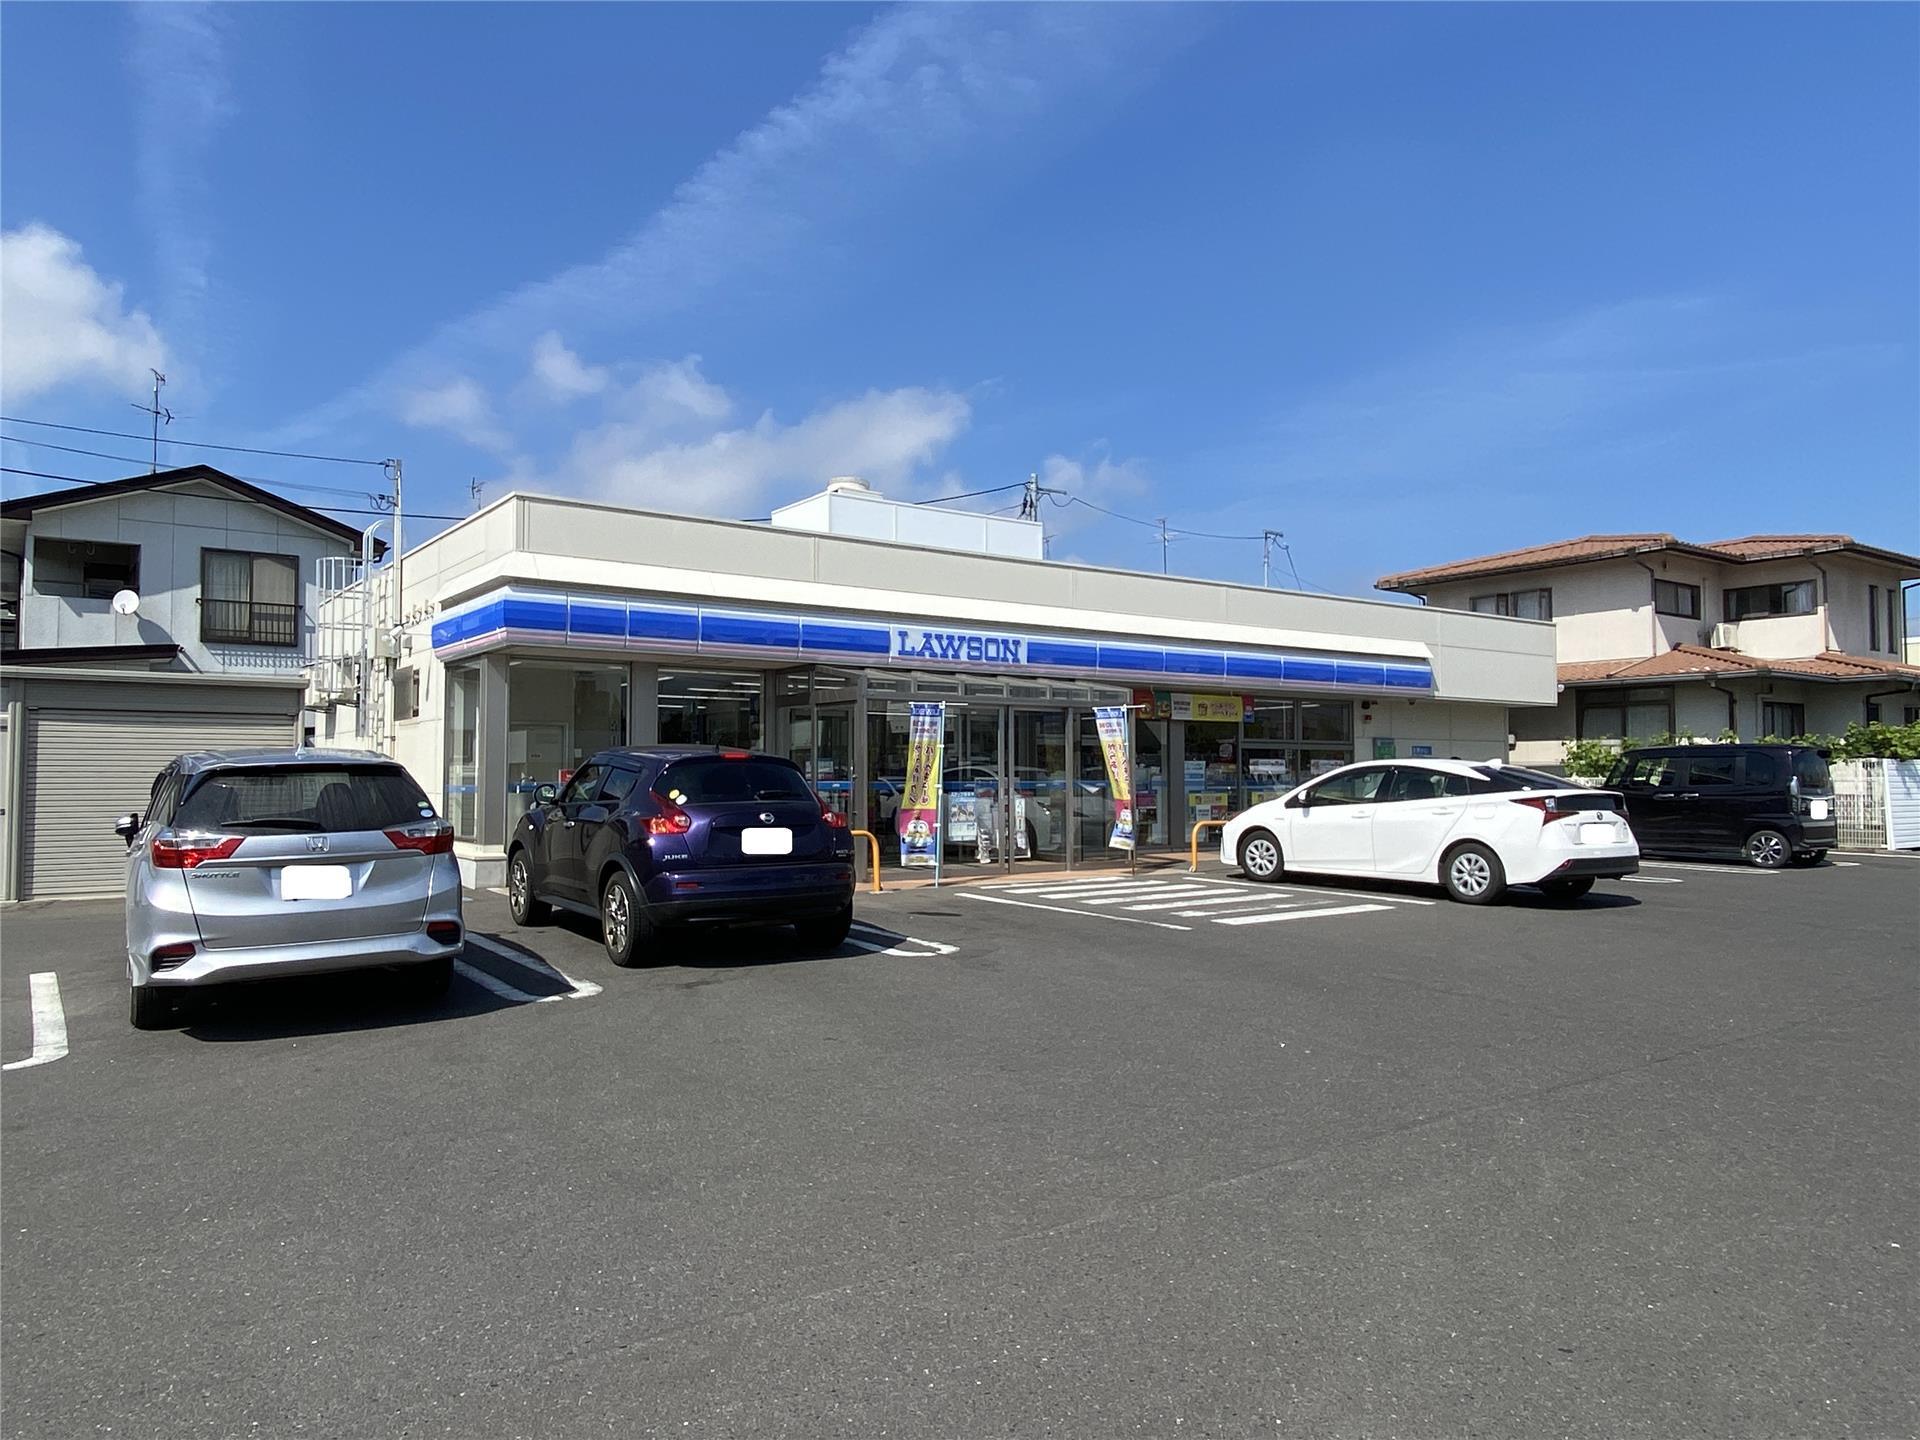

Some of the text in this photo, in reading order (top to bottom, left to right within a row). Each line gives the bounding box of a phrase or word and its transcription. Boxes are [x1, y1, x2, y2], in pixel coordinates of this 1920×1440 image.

[898, 631, 1021, 663] LAWSON
[662, 854, 688, 862] JUKE
[190, 871, 240, 879] SHUTTLE
